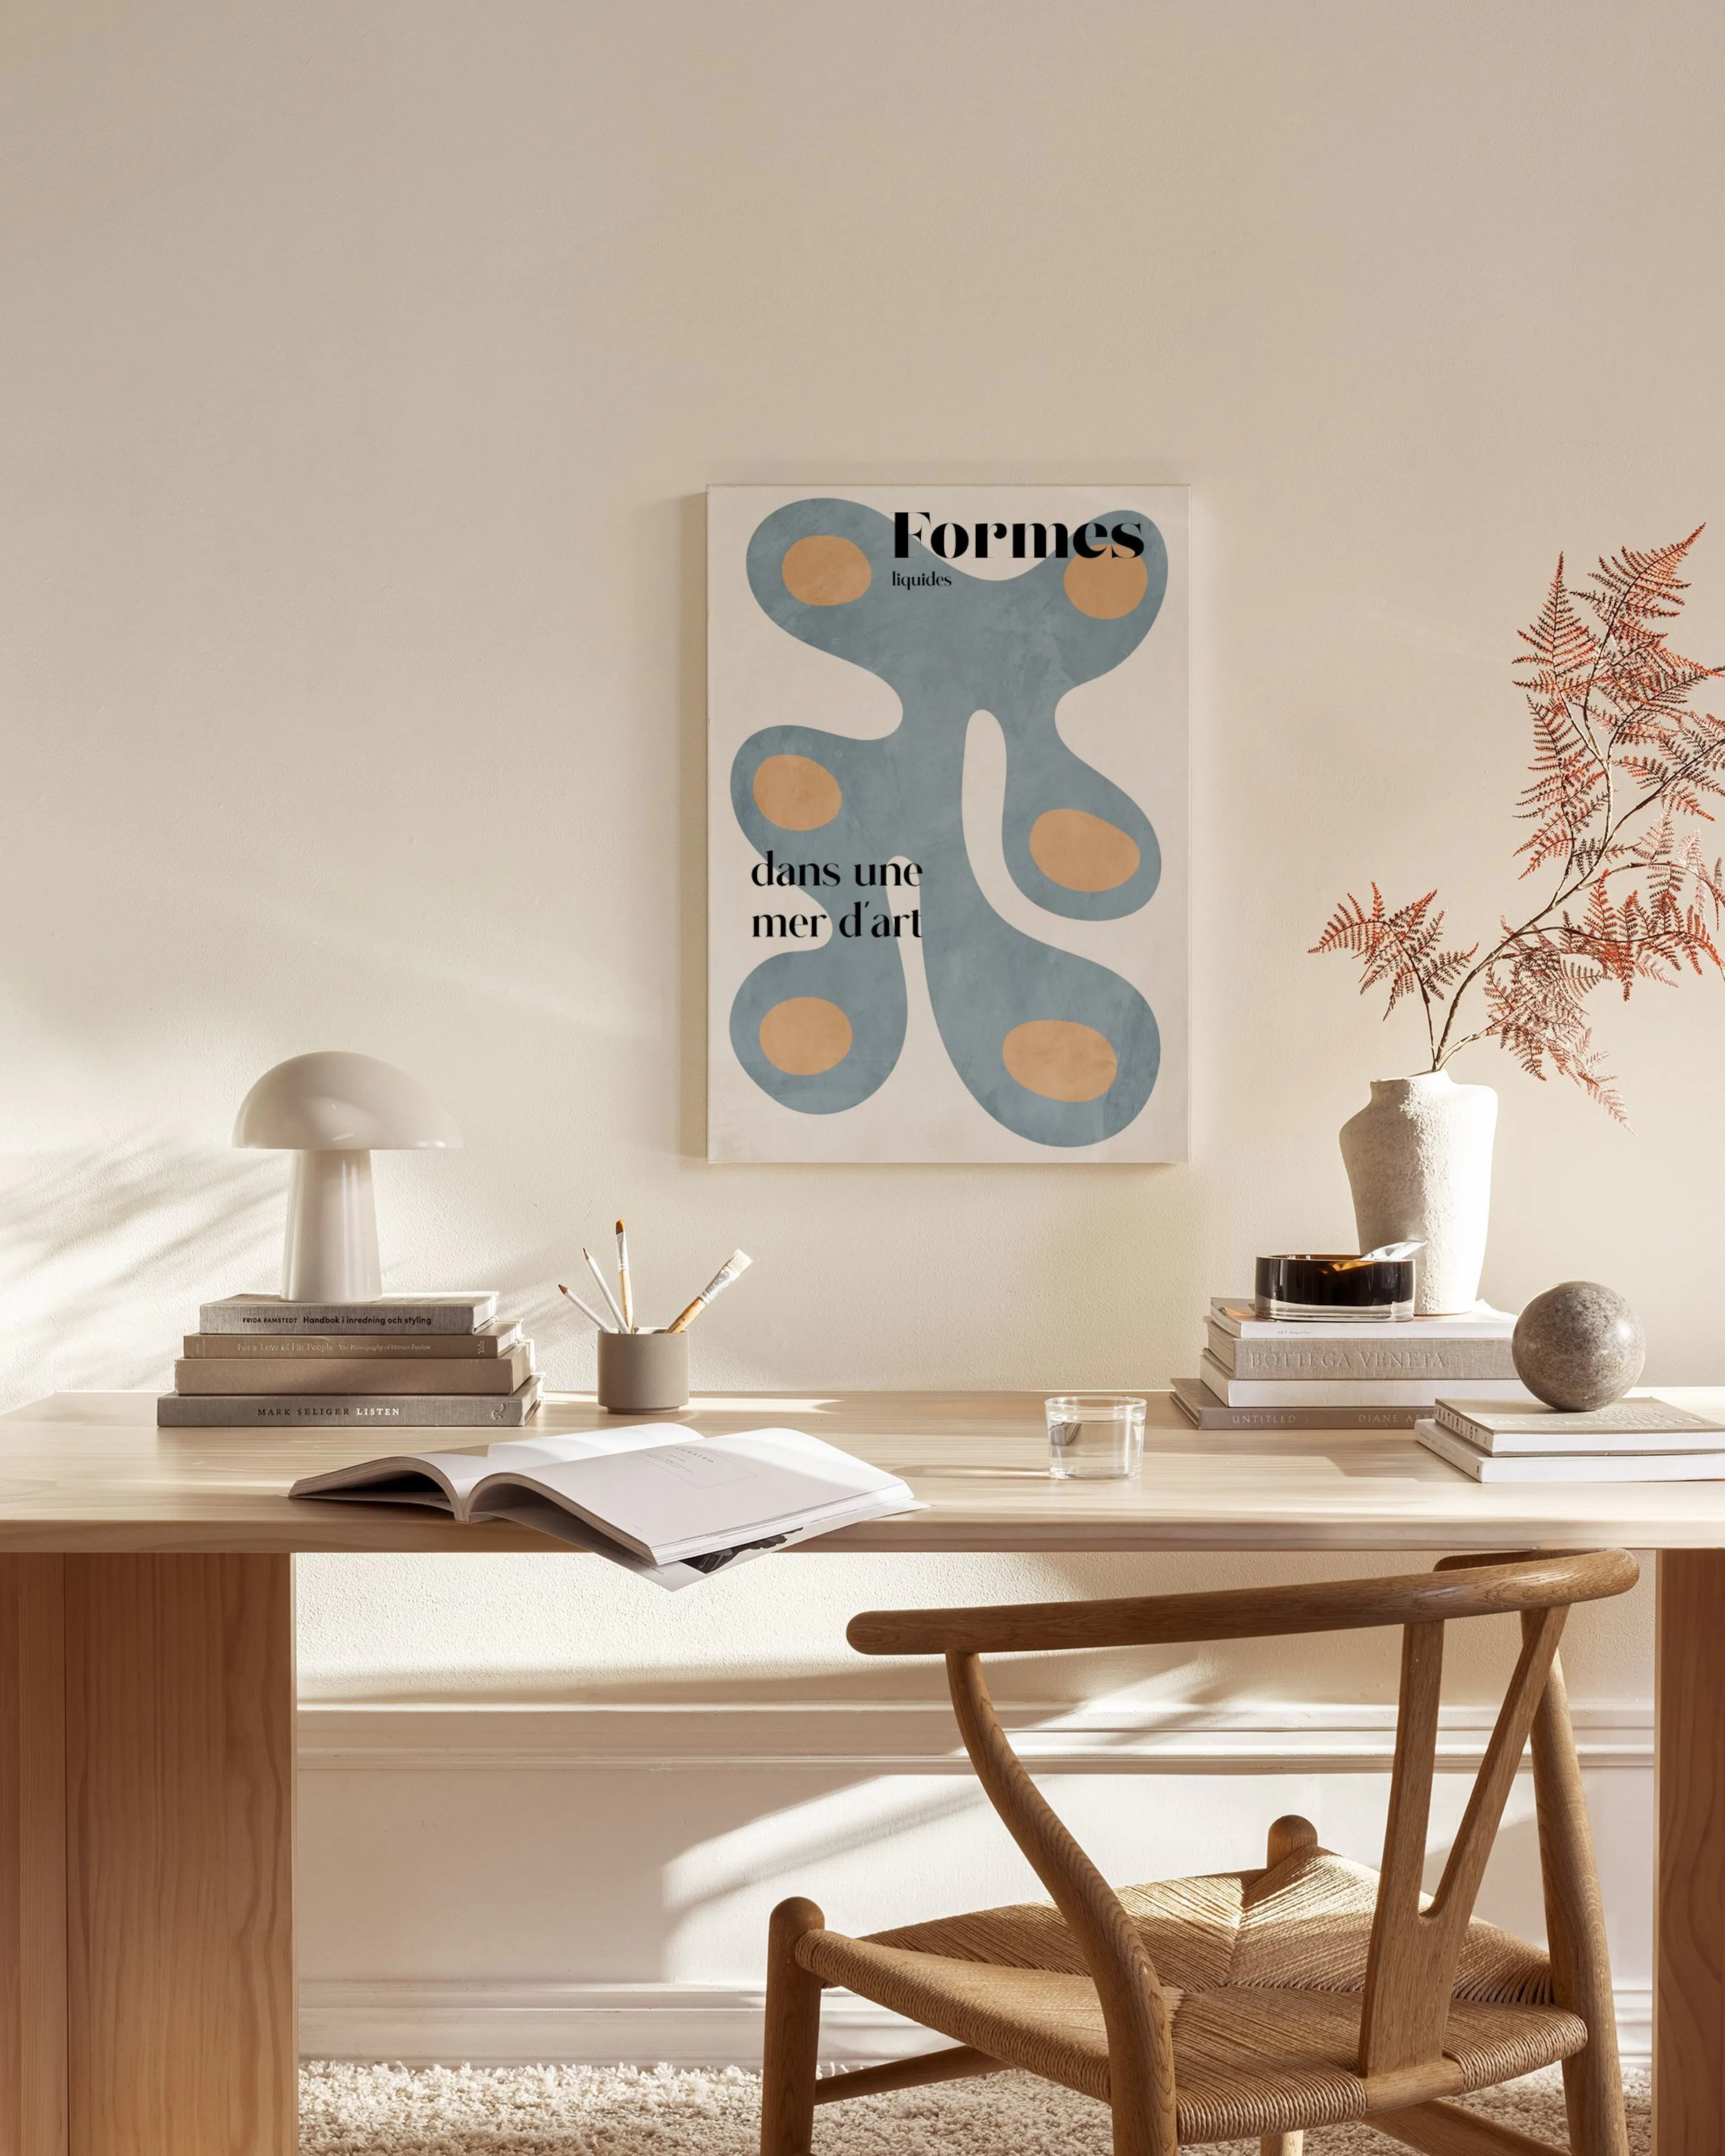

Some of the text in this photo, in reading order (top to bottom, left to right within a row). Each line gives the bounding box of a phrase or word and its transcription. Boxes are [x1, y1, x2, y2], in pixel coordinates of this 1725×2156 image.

[889, 512, 1145, 559] Formes
[892, 571, 952, 590] liquides
[751, 850, 923, 887] dans une
[752, 913, 827, 938] mer
[346, 1316, 386, 1325] inredning
[404, 1316, 432, 1325] styling
[1250, 1352, 1445, 1369] BOTTEGA VENETA
[1232, 1414, 1296, 1423] UNTITLED
[1358, 1414, 1399, 1423] DIANE
